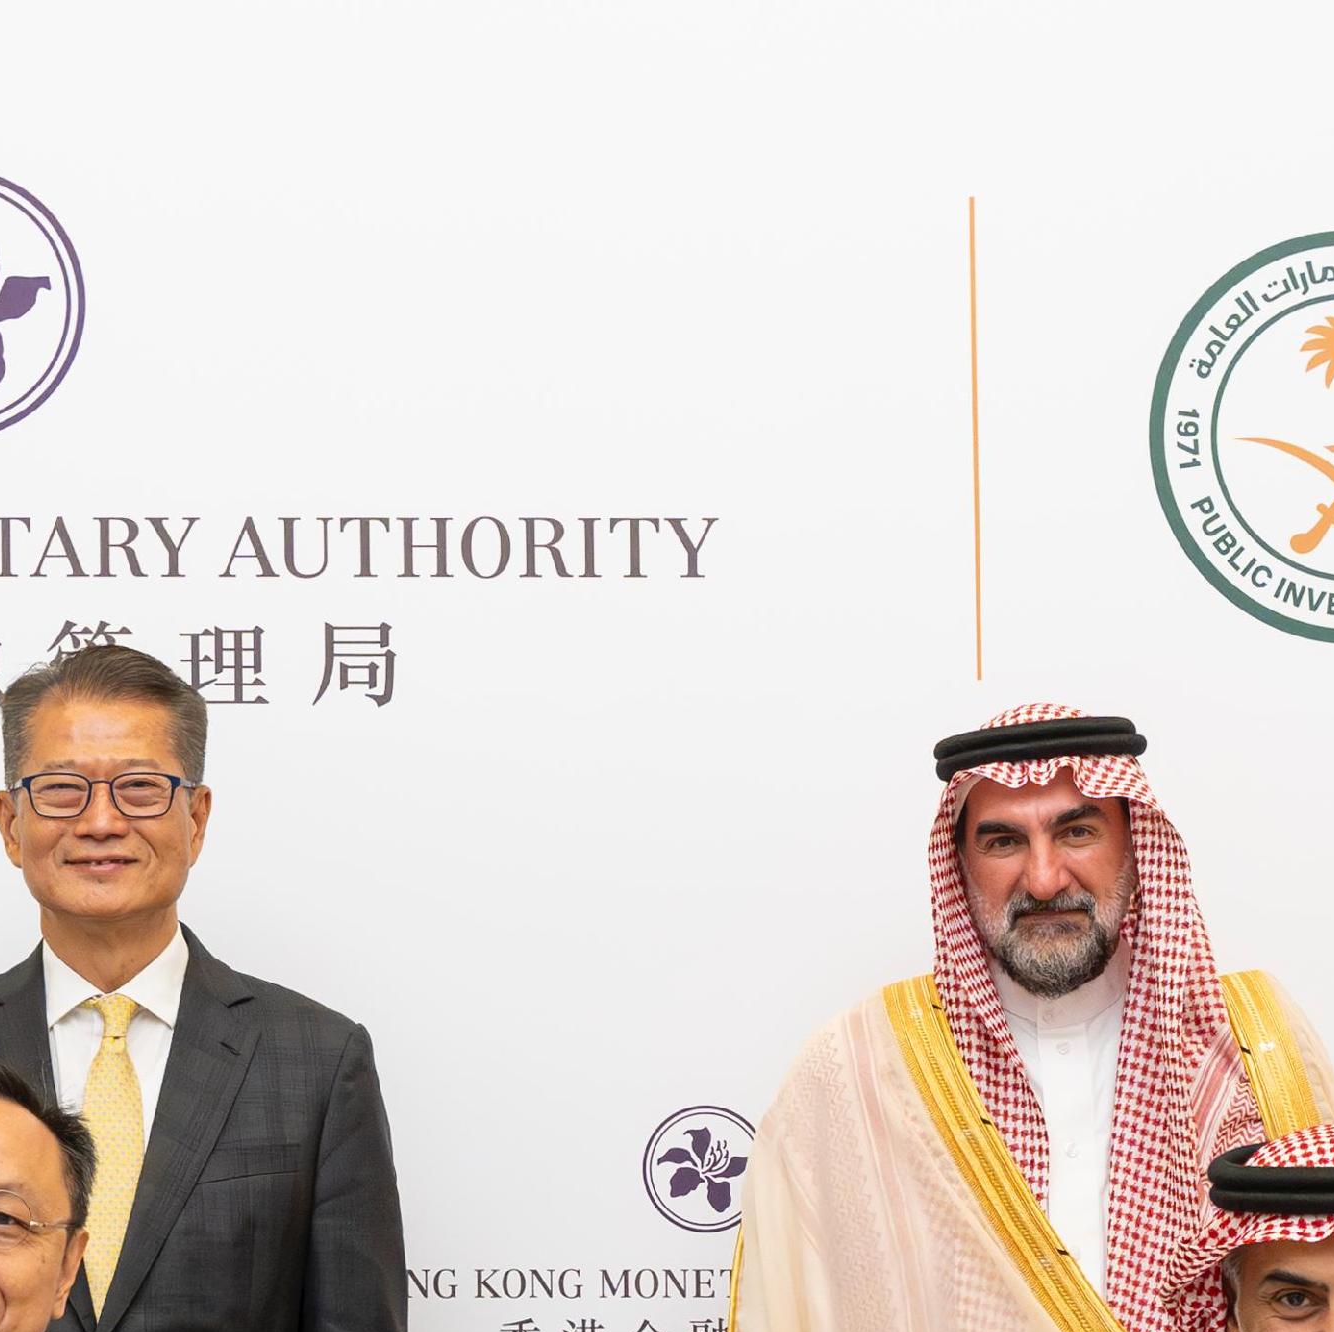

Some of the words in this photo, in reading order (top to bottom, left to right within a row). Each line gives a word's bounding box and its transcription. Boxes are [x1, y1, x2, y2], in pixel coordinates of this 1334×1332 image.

[1189, 291, 1259, 380] العامة
[1176, 409, 1200, 469] 1971
[220, 516, 719, 579] AUTHORITY
[1191, 496, 1273, 588] PUBLIC
[475, 1269, 583, 1299] KONG
